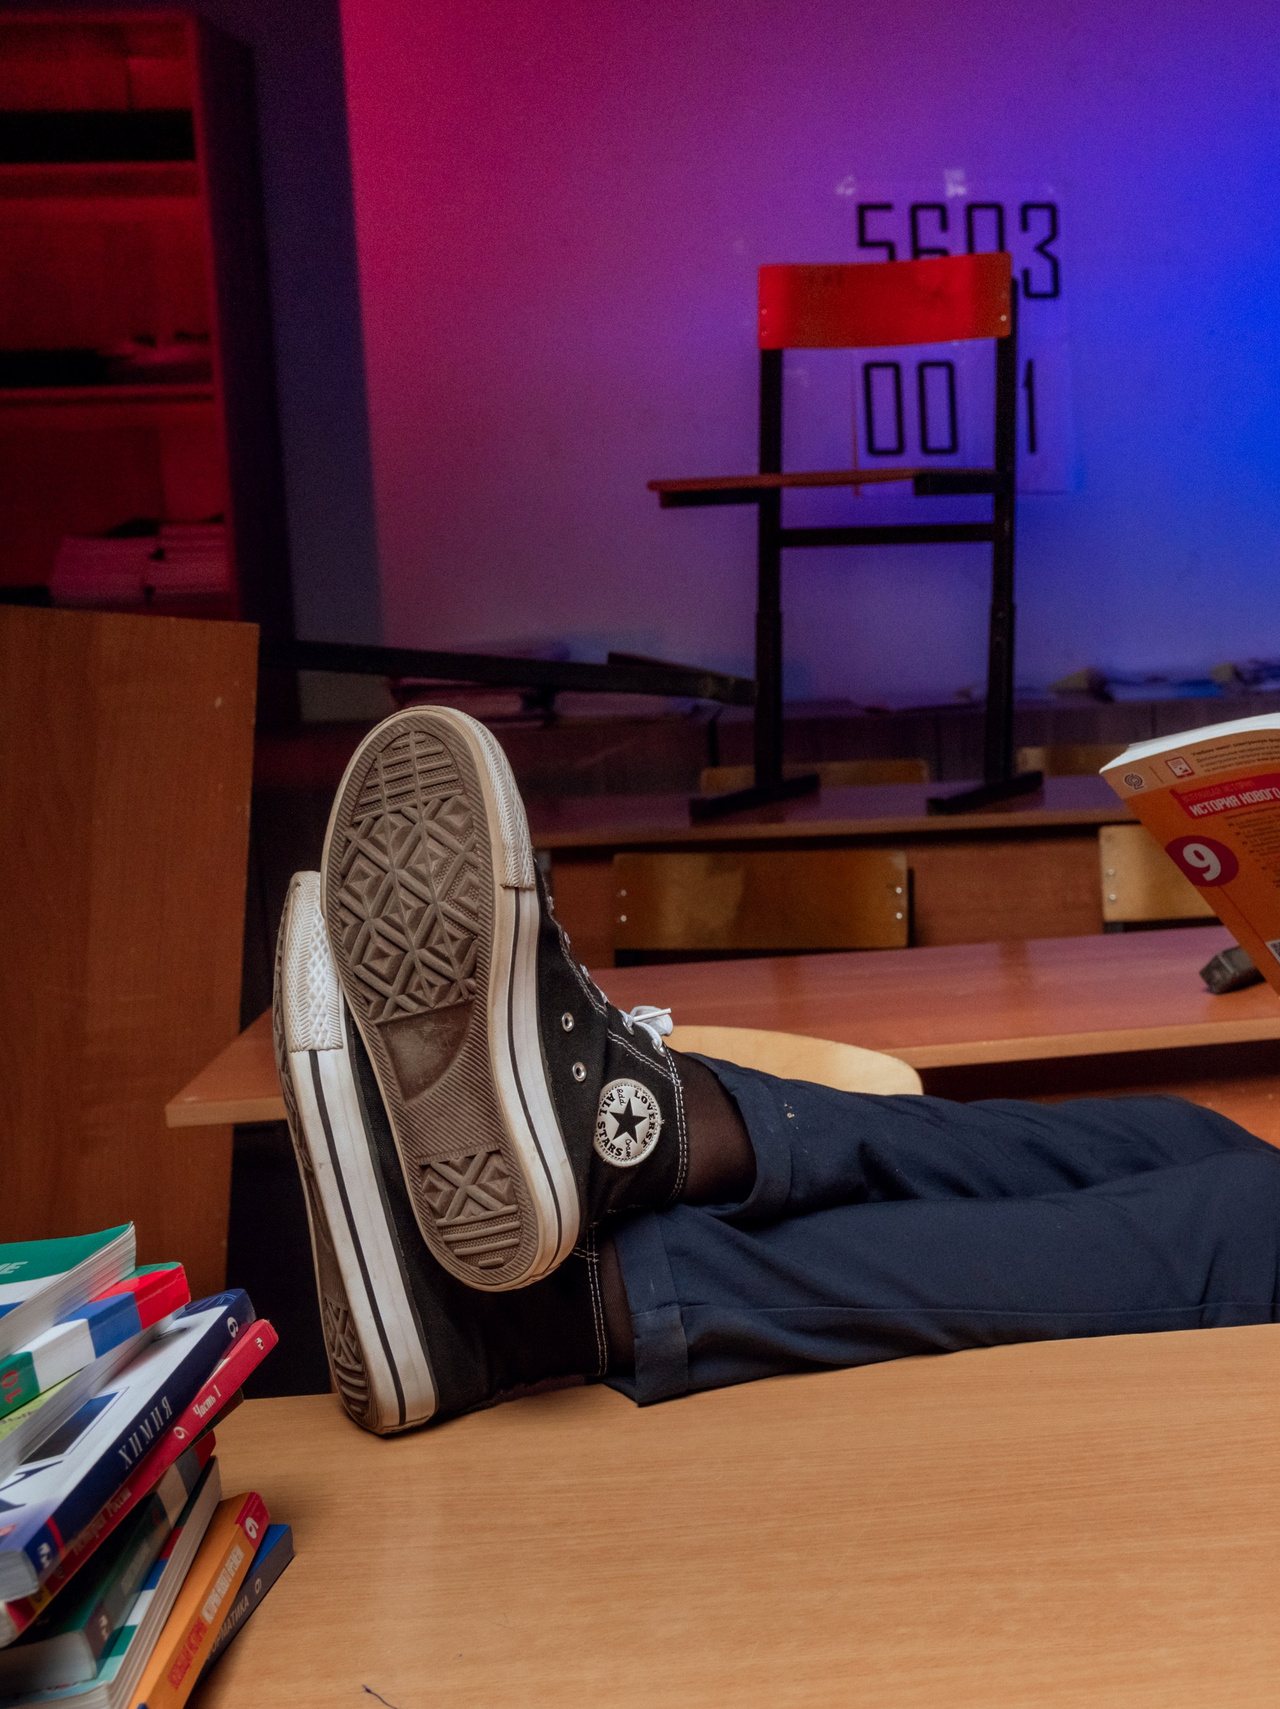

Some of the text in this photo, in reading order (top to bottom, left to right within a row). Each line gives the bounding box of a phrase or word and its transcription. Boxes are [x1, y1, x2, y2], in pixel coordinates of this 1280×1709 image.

[1188, 795, 1241, 817] ИСТОРИЯ
[1182, 843, 1222, 882] 9
[597, 1092, 624, 1157] ALL STARS
[118, 1396, 173, 1470] ХИМИЯ
[227, 1315, 239, 1338] 9
[173, 1426, 189, 1440] 9
[193, 1393, 217, 1419] Часть
[244, 1516, 259, 1539] 9
